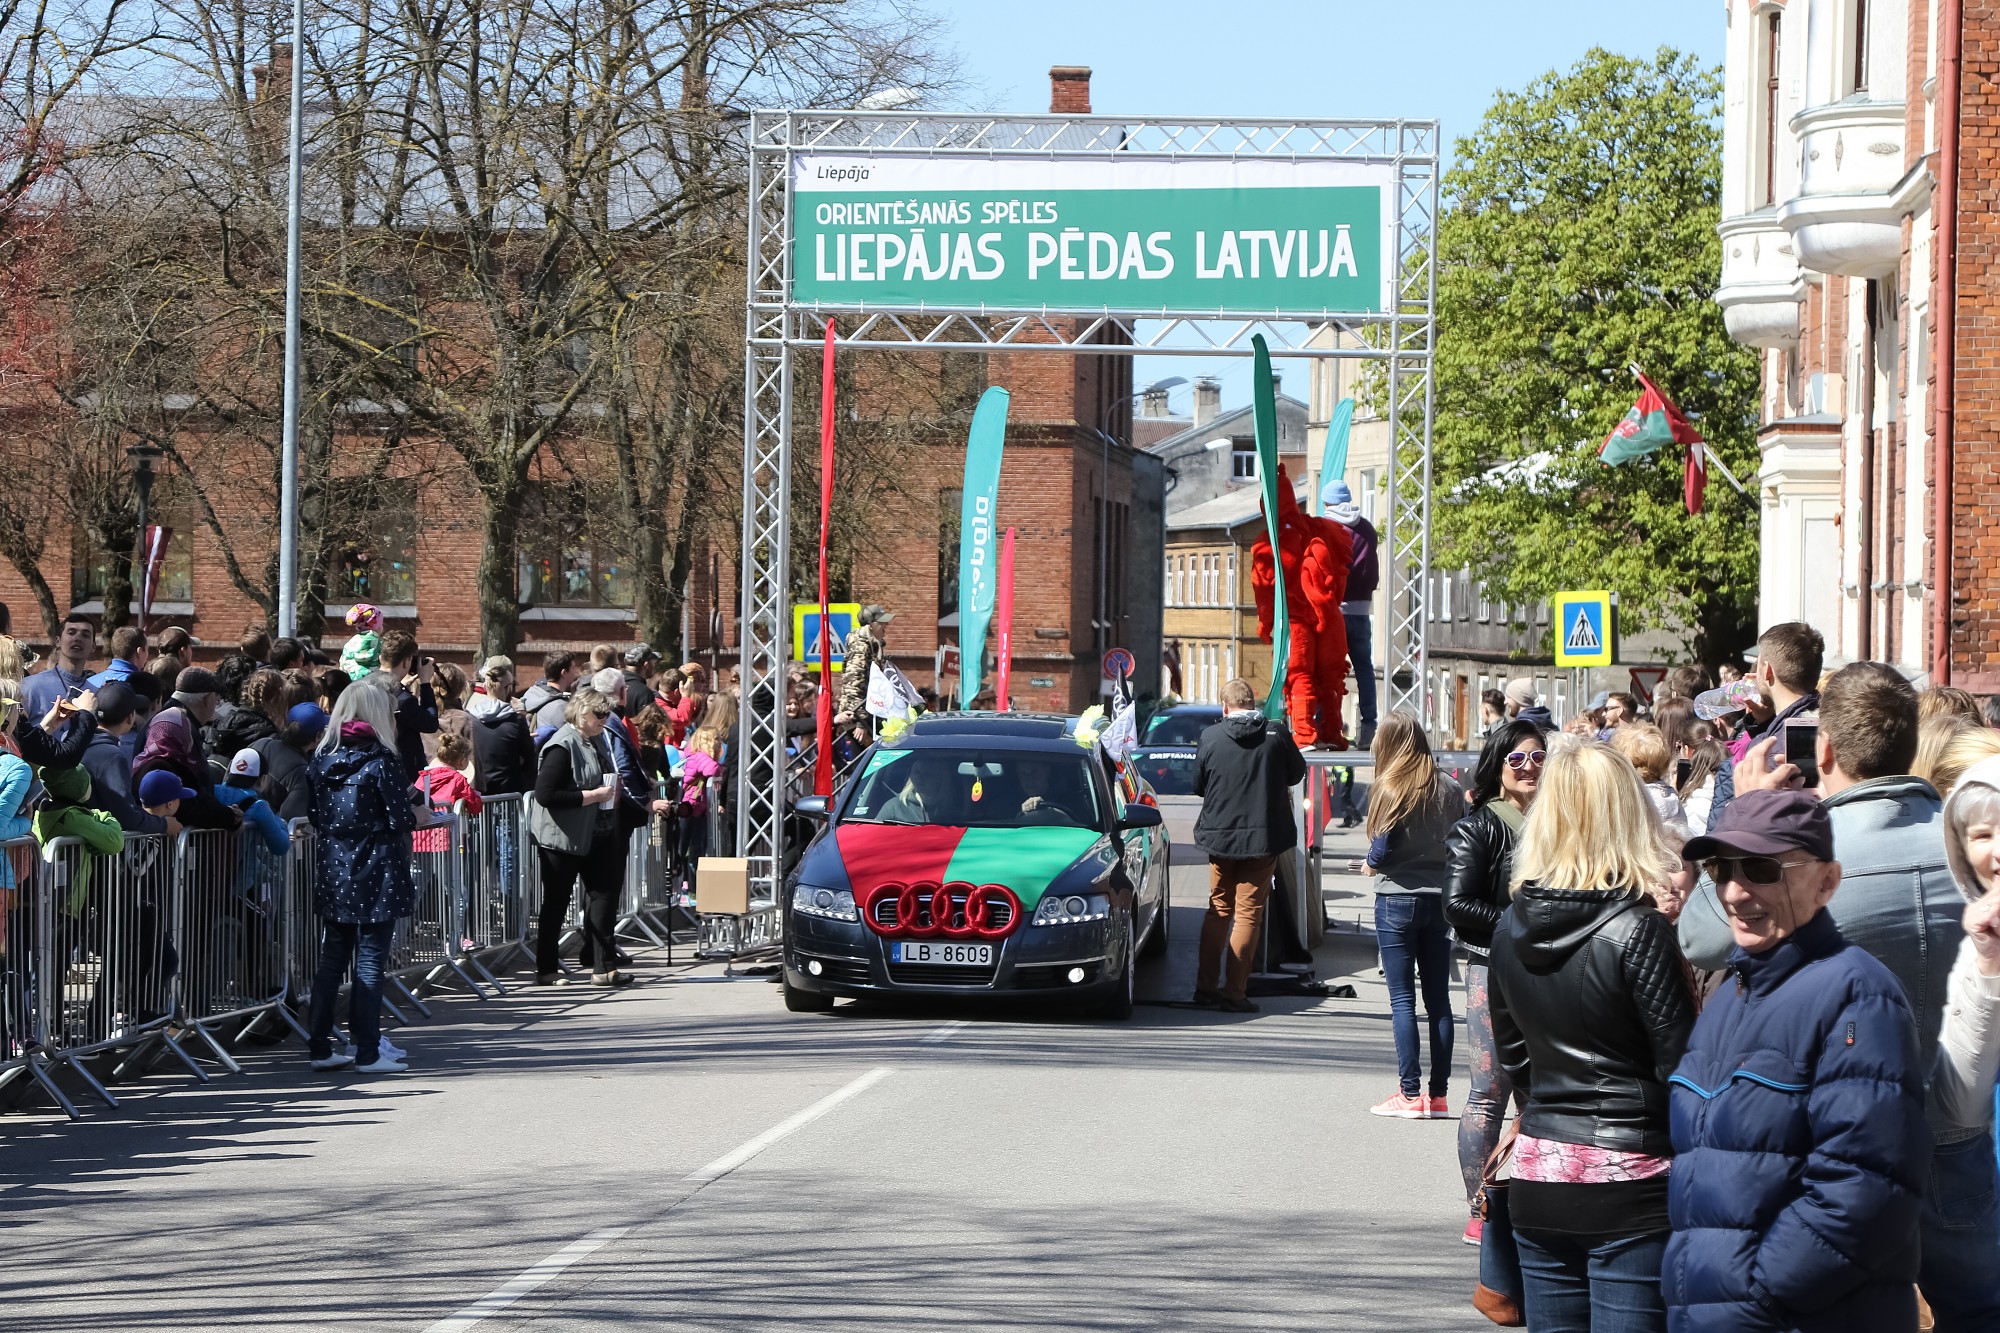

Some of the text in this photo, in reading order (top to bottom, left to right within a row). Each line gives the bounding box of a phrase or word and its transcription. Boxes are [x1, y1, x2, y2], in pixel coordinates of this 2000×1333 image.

[817, 165, 870, 182] Liepāja
[815, 199, 1058, 225] ORIENTĒŠANĀS SPĒLES
[815, 224, 1358, 281] LIEPĀJAS PĒDAS LATVIJĀ
[905, 944, 989, 963] LB-8609
